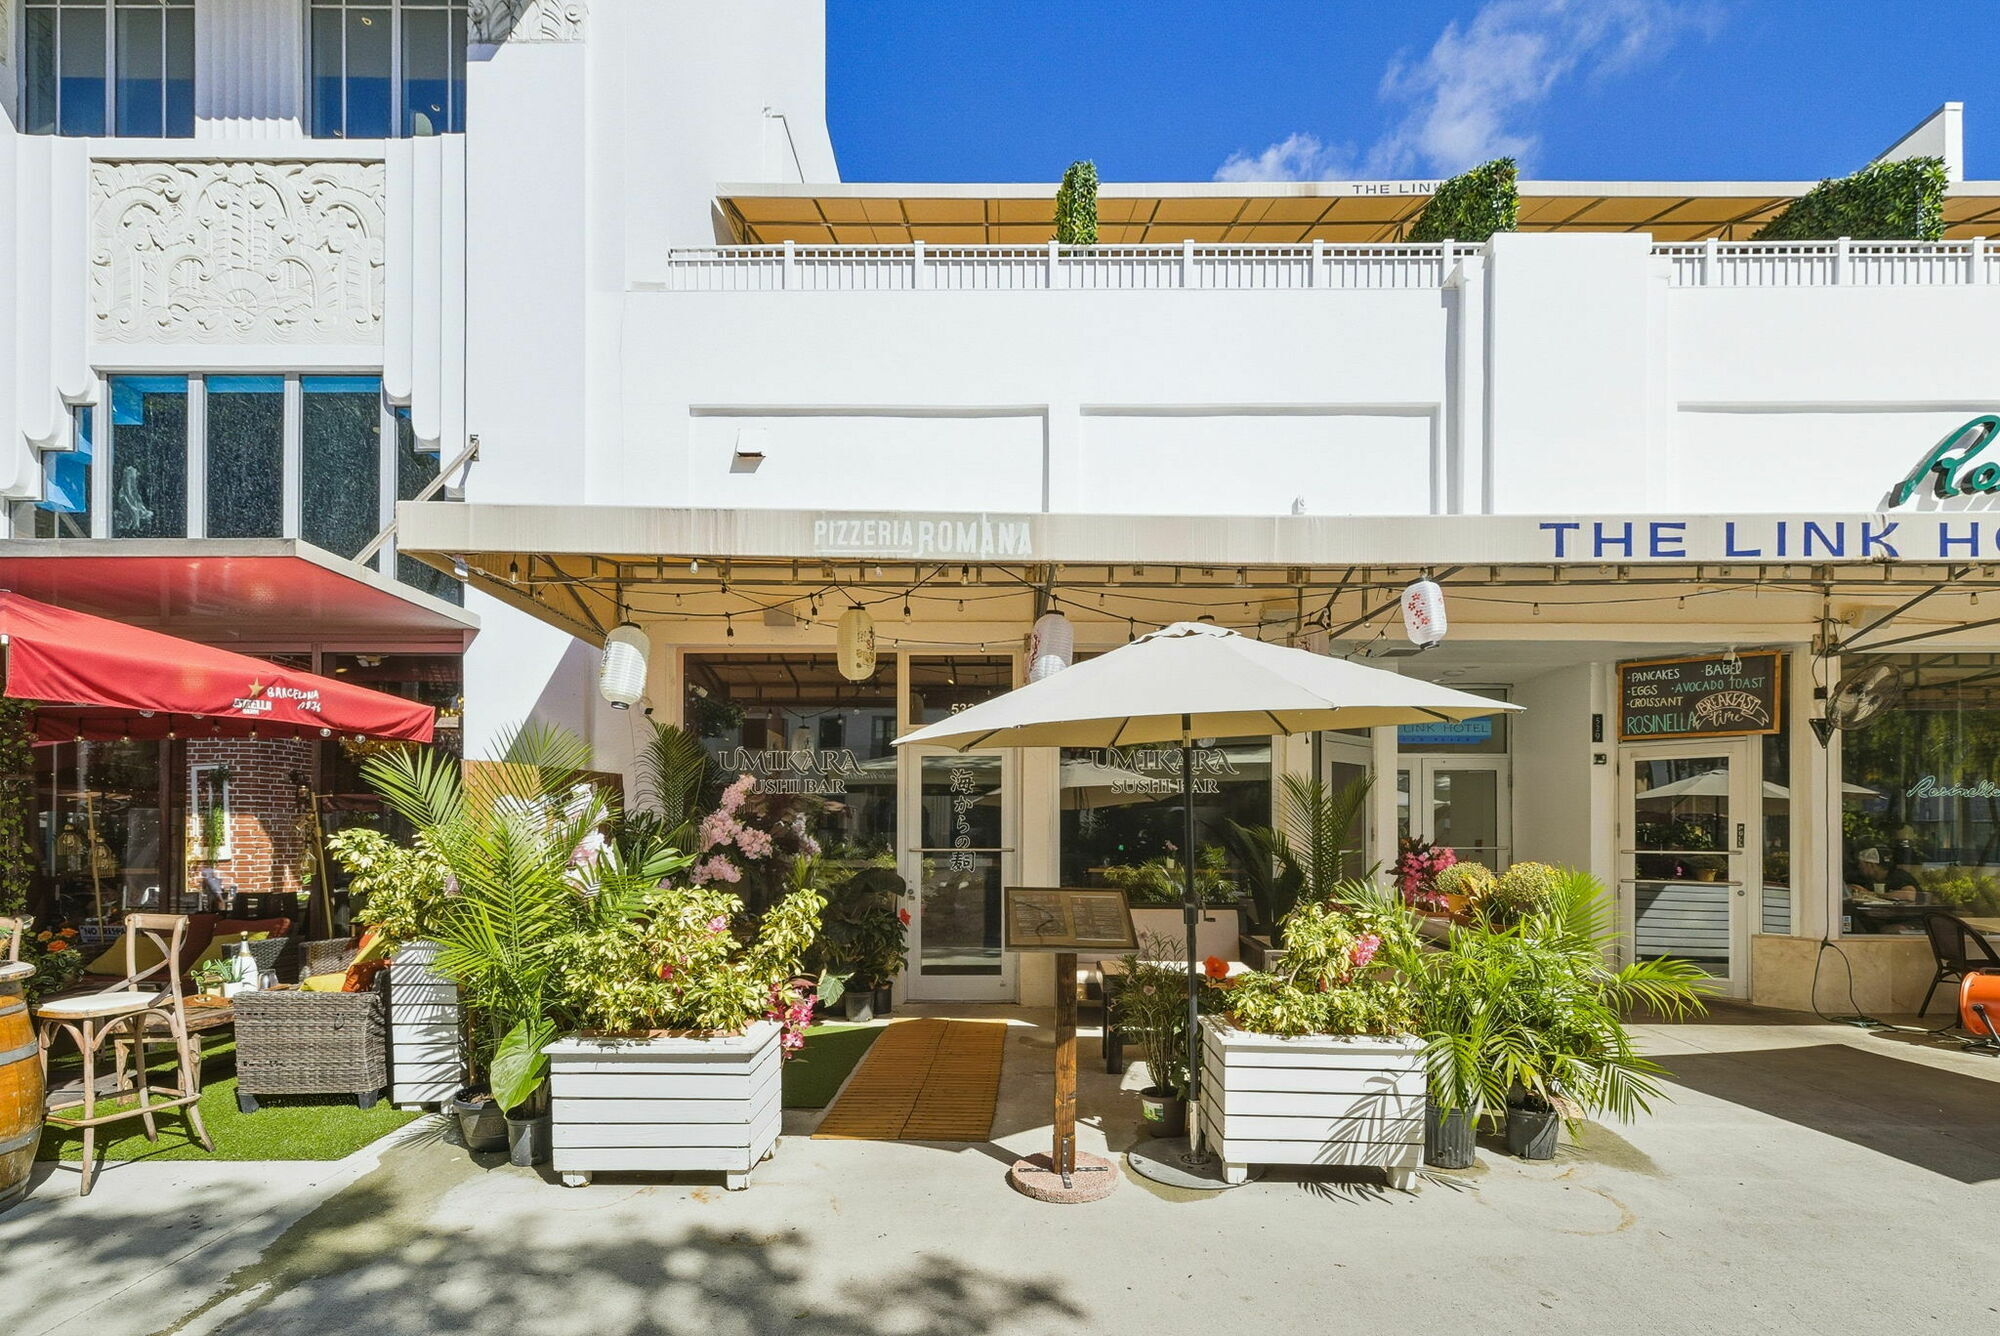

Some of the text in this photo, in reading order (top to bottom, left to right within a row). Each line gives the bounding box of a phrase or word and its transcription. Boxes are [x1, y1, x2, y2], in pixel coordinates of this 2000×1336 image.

[1353, 184, 1390, 194] THE
[814, 519, 1032, 557] PIZZERIA ROMANA
[1539, 521, 2000, 558] THE LINK H
[1632, 668, 1680, 683] PANCAKES
[267, 687, 319, 700] BARCELONA
[1632, 685, 1657, 697] EGGS
[1674, 680, 1724, 693] AVOCADO
[1629, 696, 1683, 708] CROISSANT
[1699, 692, 1759, 716] BREAKFAST
[1403, 724, 1488, 733] LINK HOTEL
[1627, 711, 1695, 734] ROSINELLA
[718, 746, 867, 776] UMIKARA
[1090, 747, 1240, 775] UMIKARA
[750, 779, 847, 794] USHI BAR
[1111, 779, 1171, 793] SUSHI
